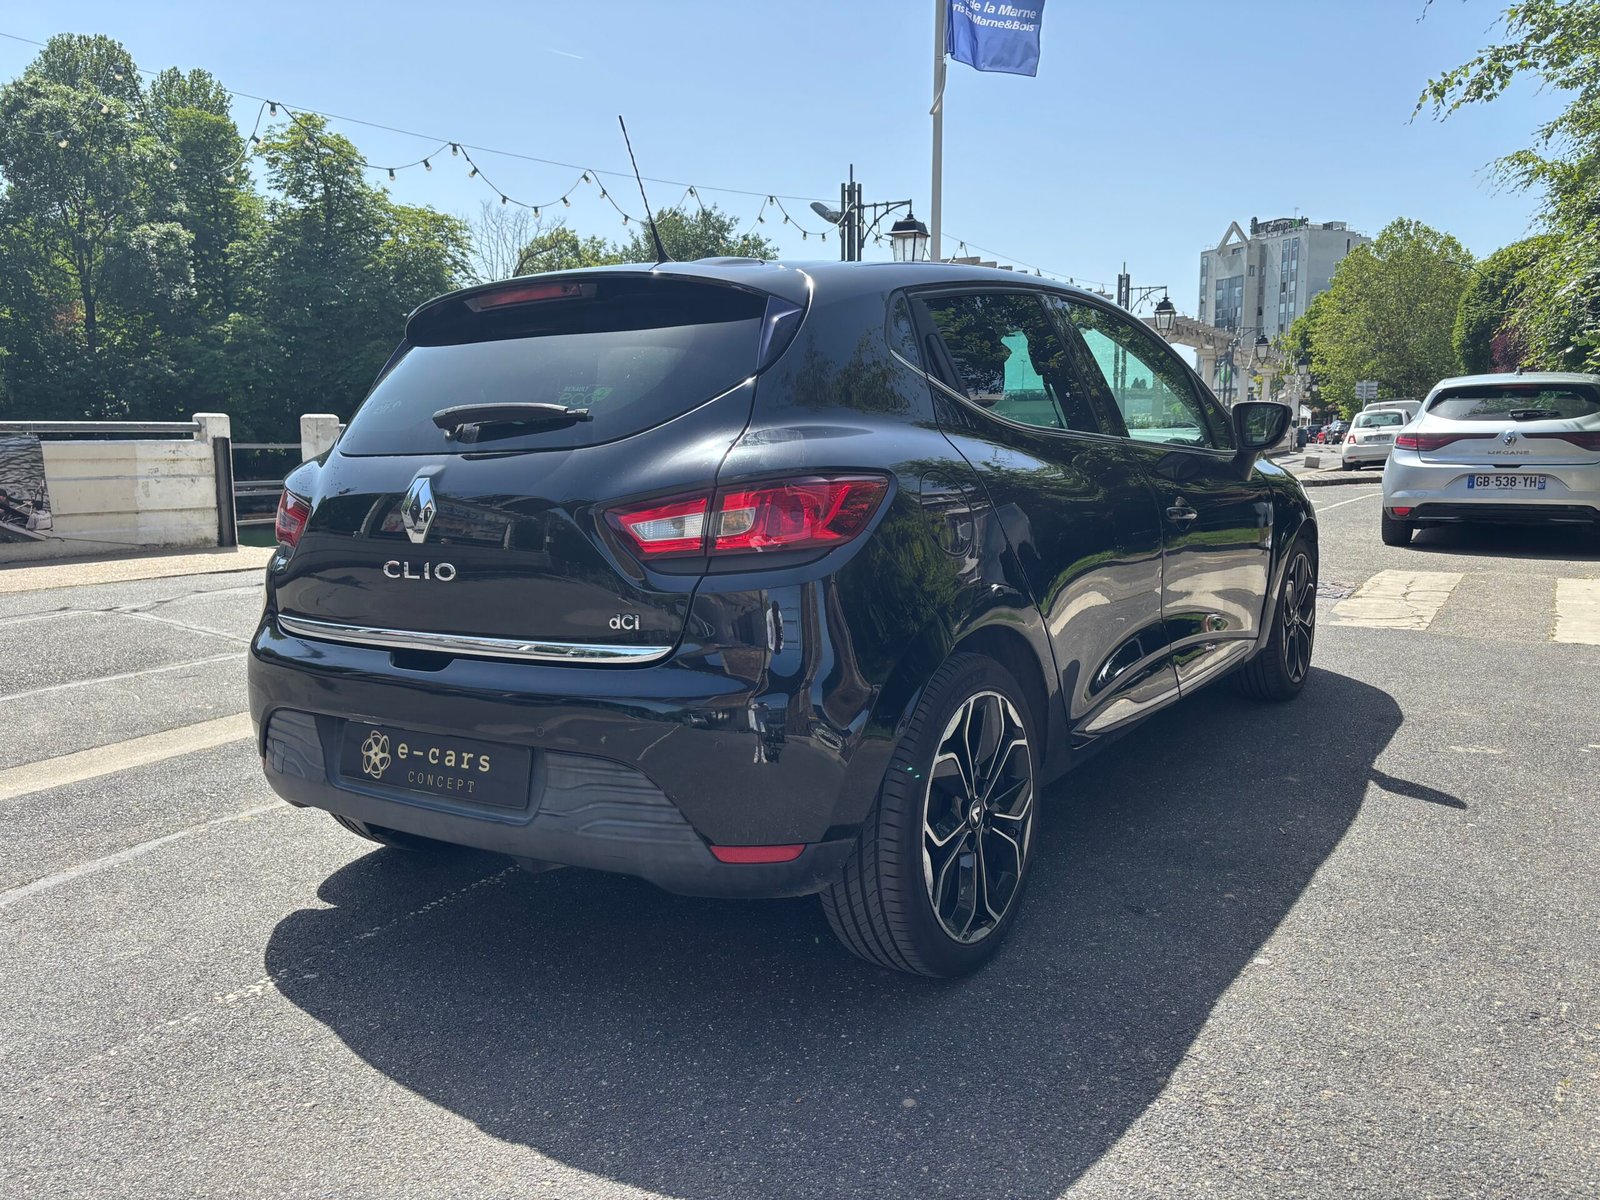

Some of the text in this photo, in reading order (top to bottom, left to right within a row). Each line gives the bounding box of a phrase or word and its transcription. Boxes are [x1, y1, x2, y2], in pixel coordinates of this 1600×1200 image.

[970, 0, 981, 11] de
[984, 2, 995, 13] la
[998, 5, 1036, 19] Marne
[972, 14, 1034, 32] Marne&Bois
[1476, 476, 1537, 488] GB-538-YH
[383, 560, 457, 582] CLIO
[397, 742, 491, 772] e-cars
[408, 771, 475, 793] CONCEPT
